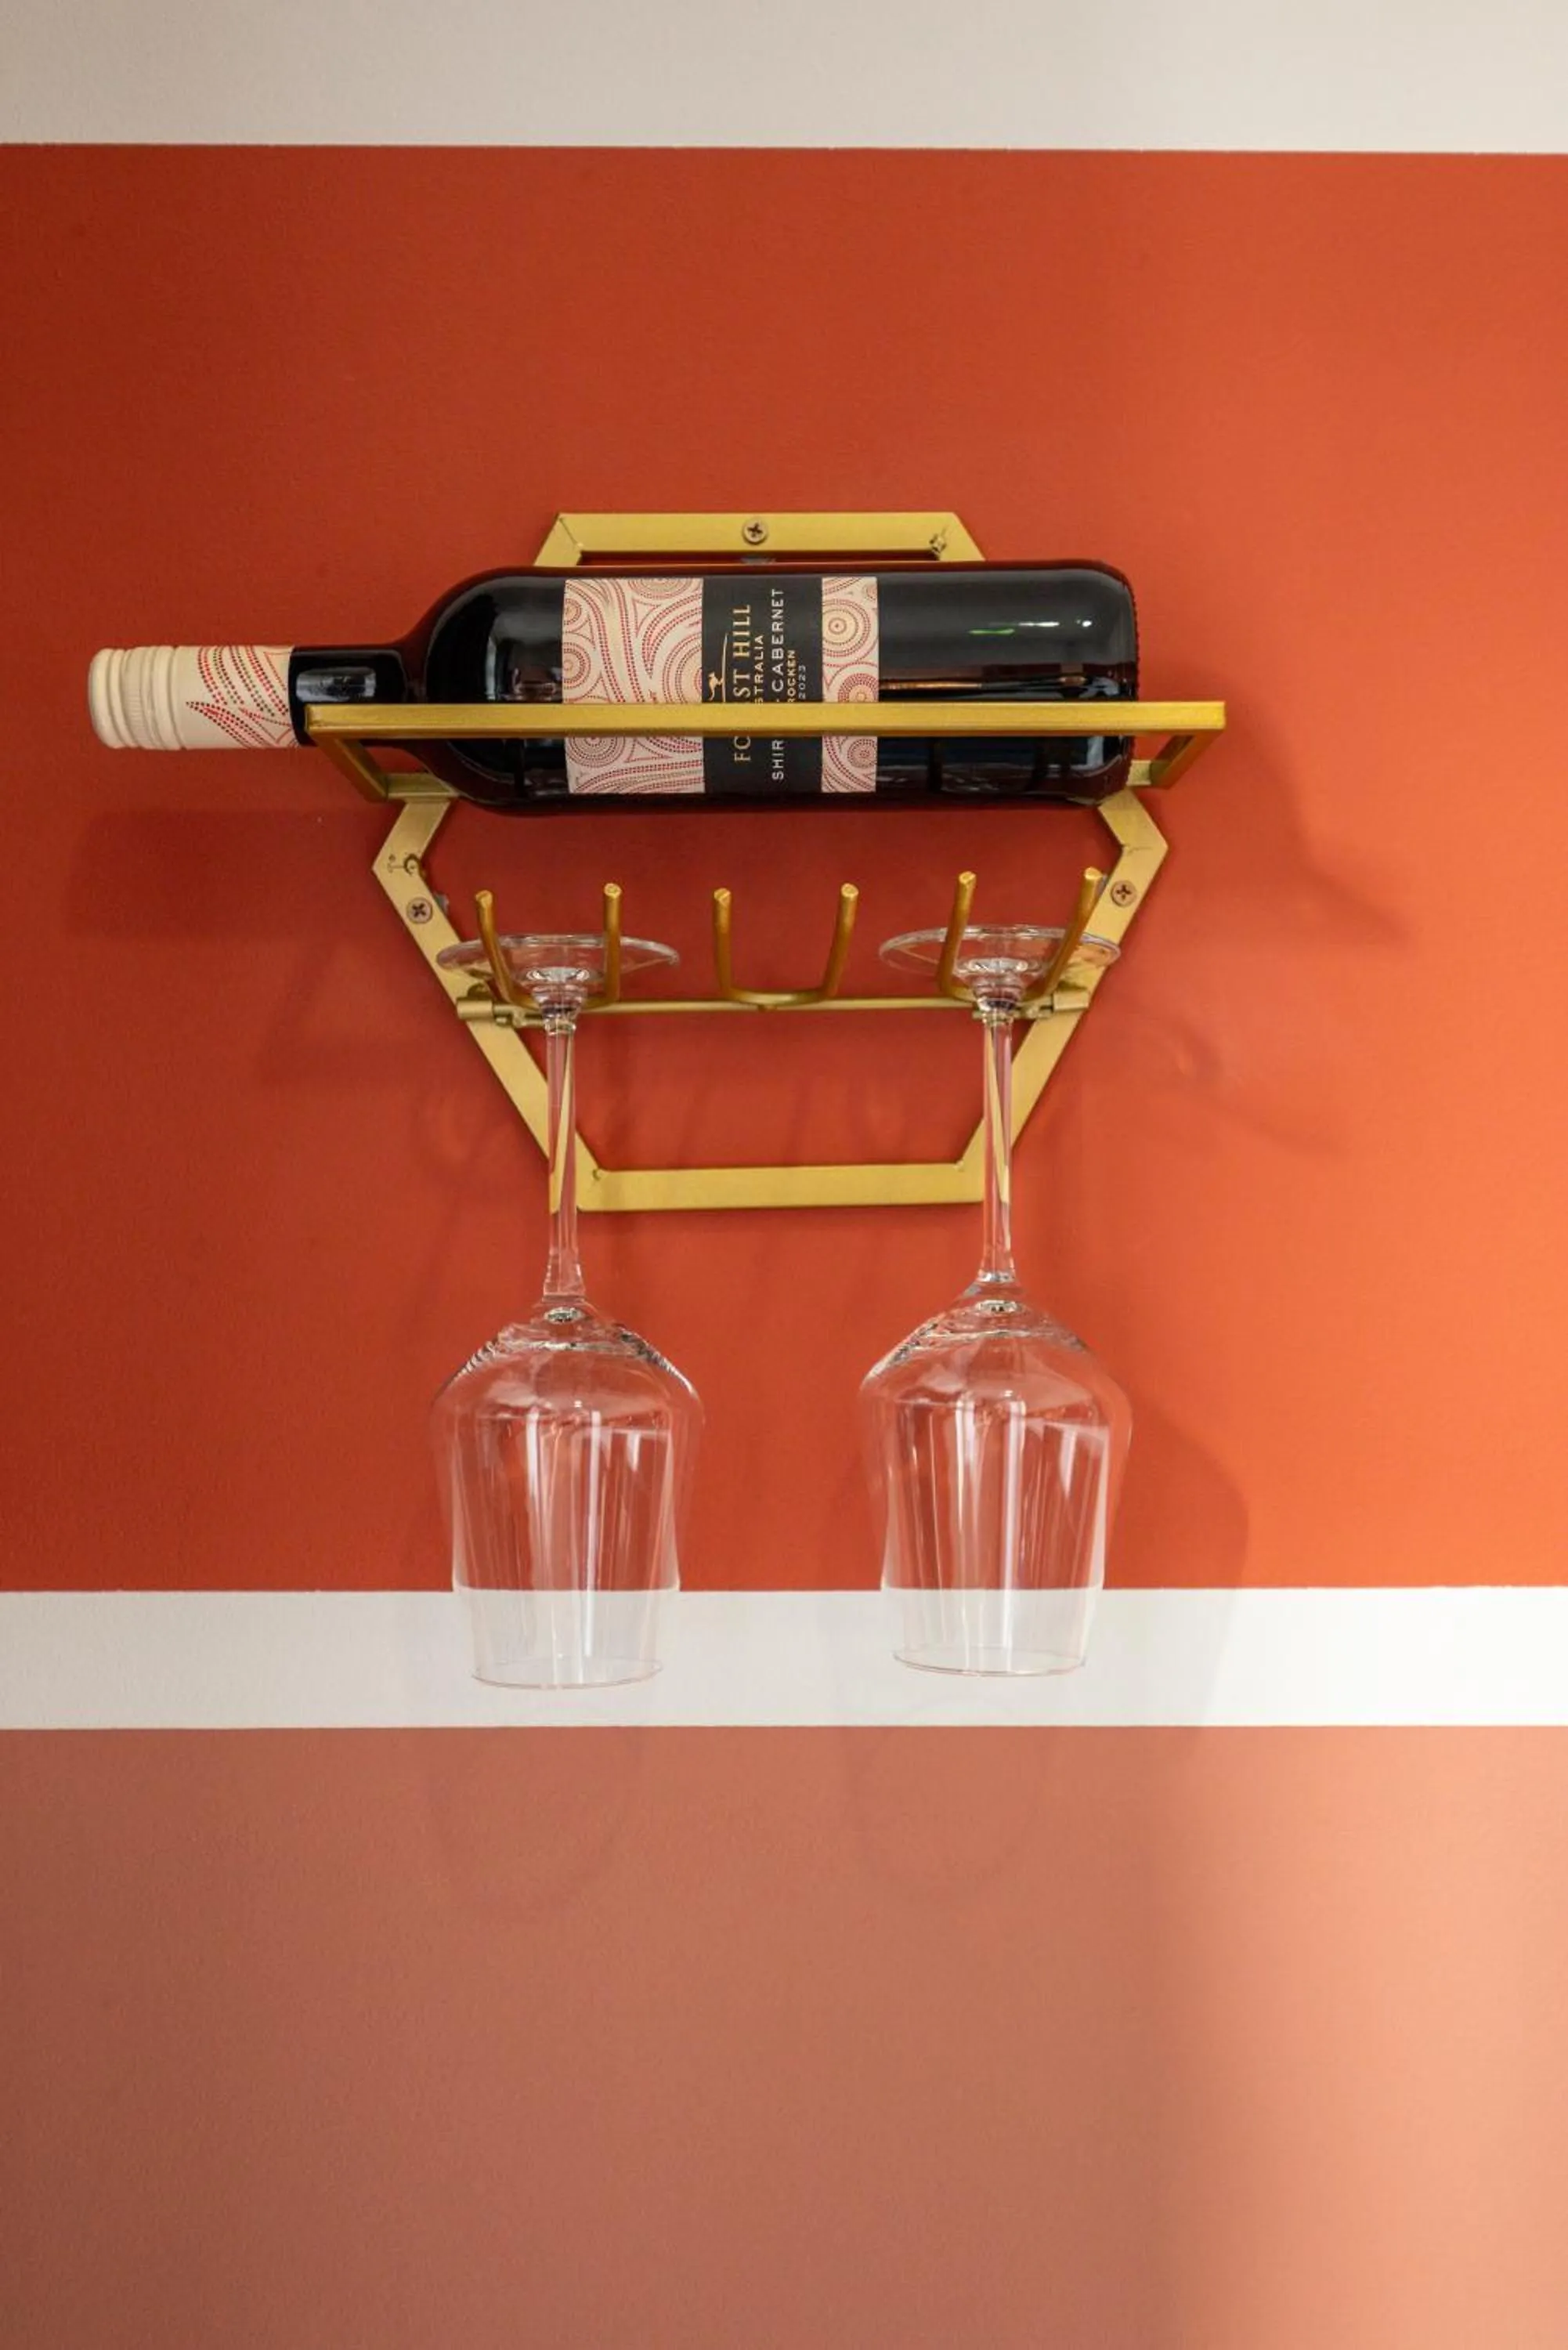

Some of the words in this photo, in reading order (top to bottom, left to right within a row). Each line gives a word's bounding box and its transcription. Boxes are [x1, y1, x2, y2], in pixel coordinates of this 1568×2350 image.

[732, 604, 751, 658] HILL
[771, 588, 784, 692] CABERNET
[754, 634, 764, 705] STRALIA
[787, 649, 797, 703] ROCKEN
[732, 669, 751, 762] FOST
[771, 739, 784, 781] SHIR
